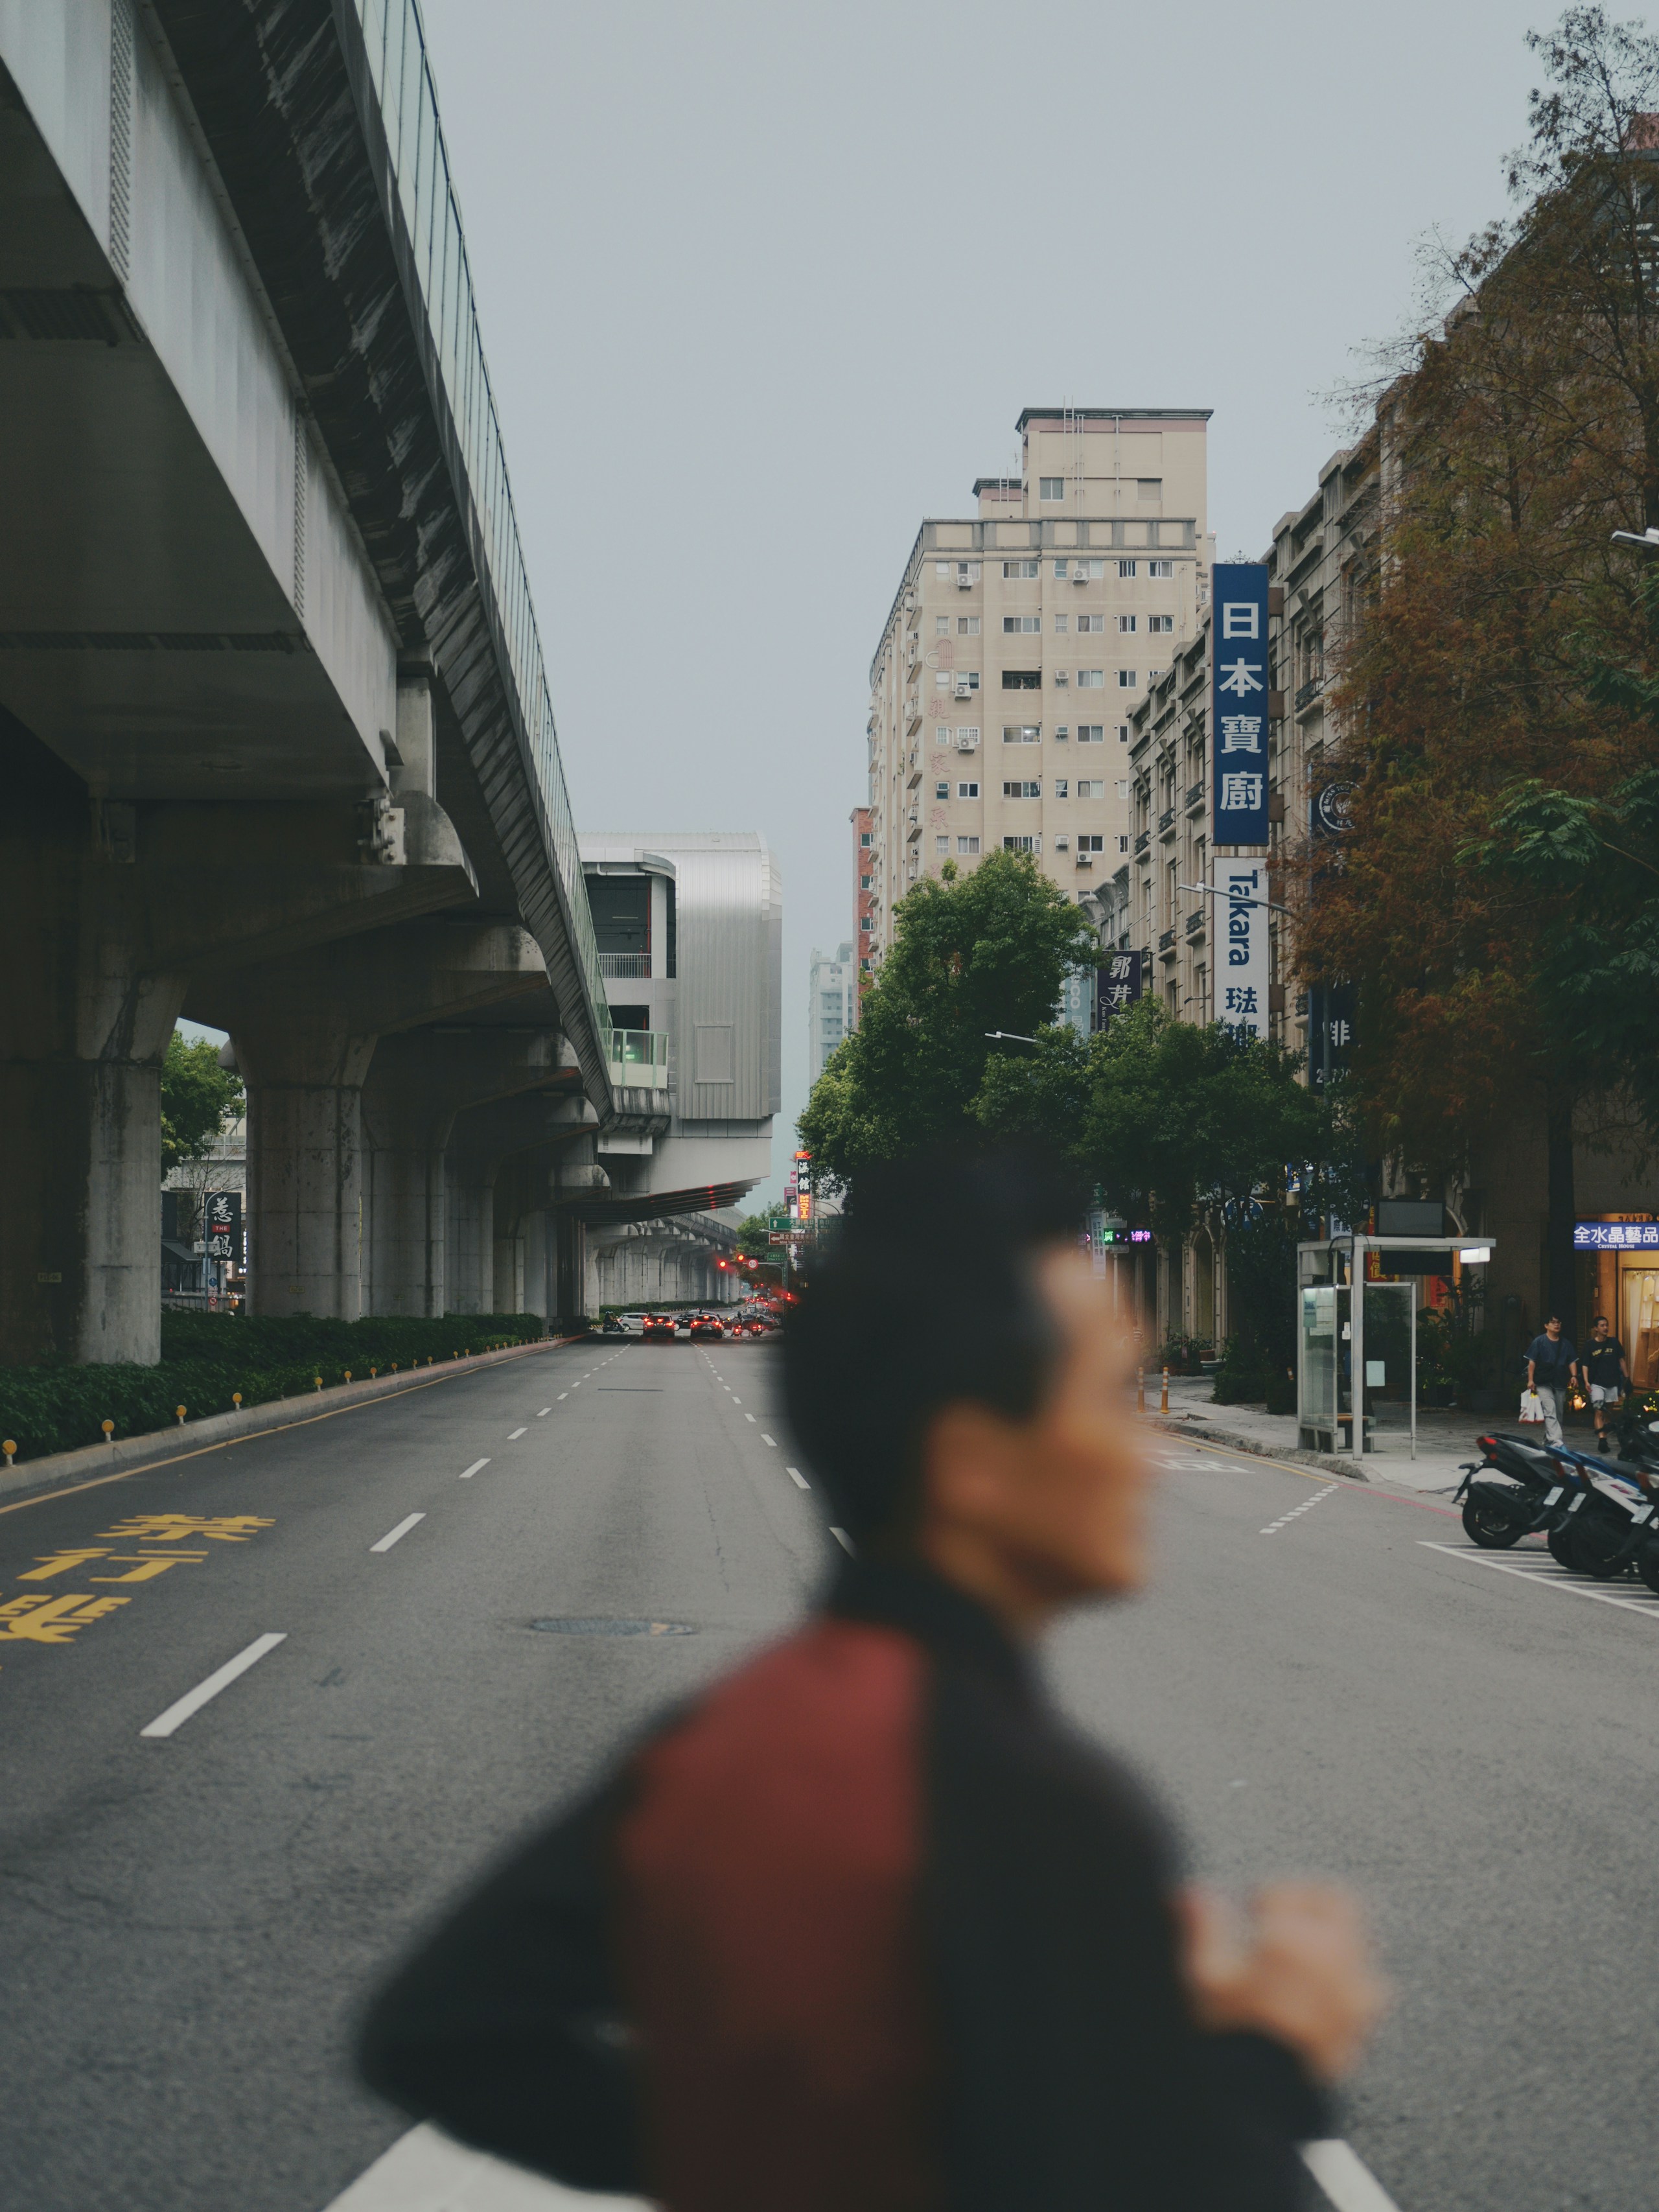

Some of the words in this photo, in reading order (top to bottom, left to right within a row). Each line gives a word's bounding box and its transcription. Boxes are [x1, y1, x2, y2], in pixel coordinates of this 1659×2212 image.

[1218, 602, 1264, 811] 日本寶廚
[1229, 869, 1258, 966] Takara
[211, 1196, 233, 1223] 惹
[1573, 1226, 1659, 1244] 全水晶藝品
